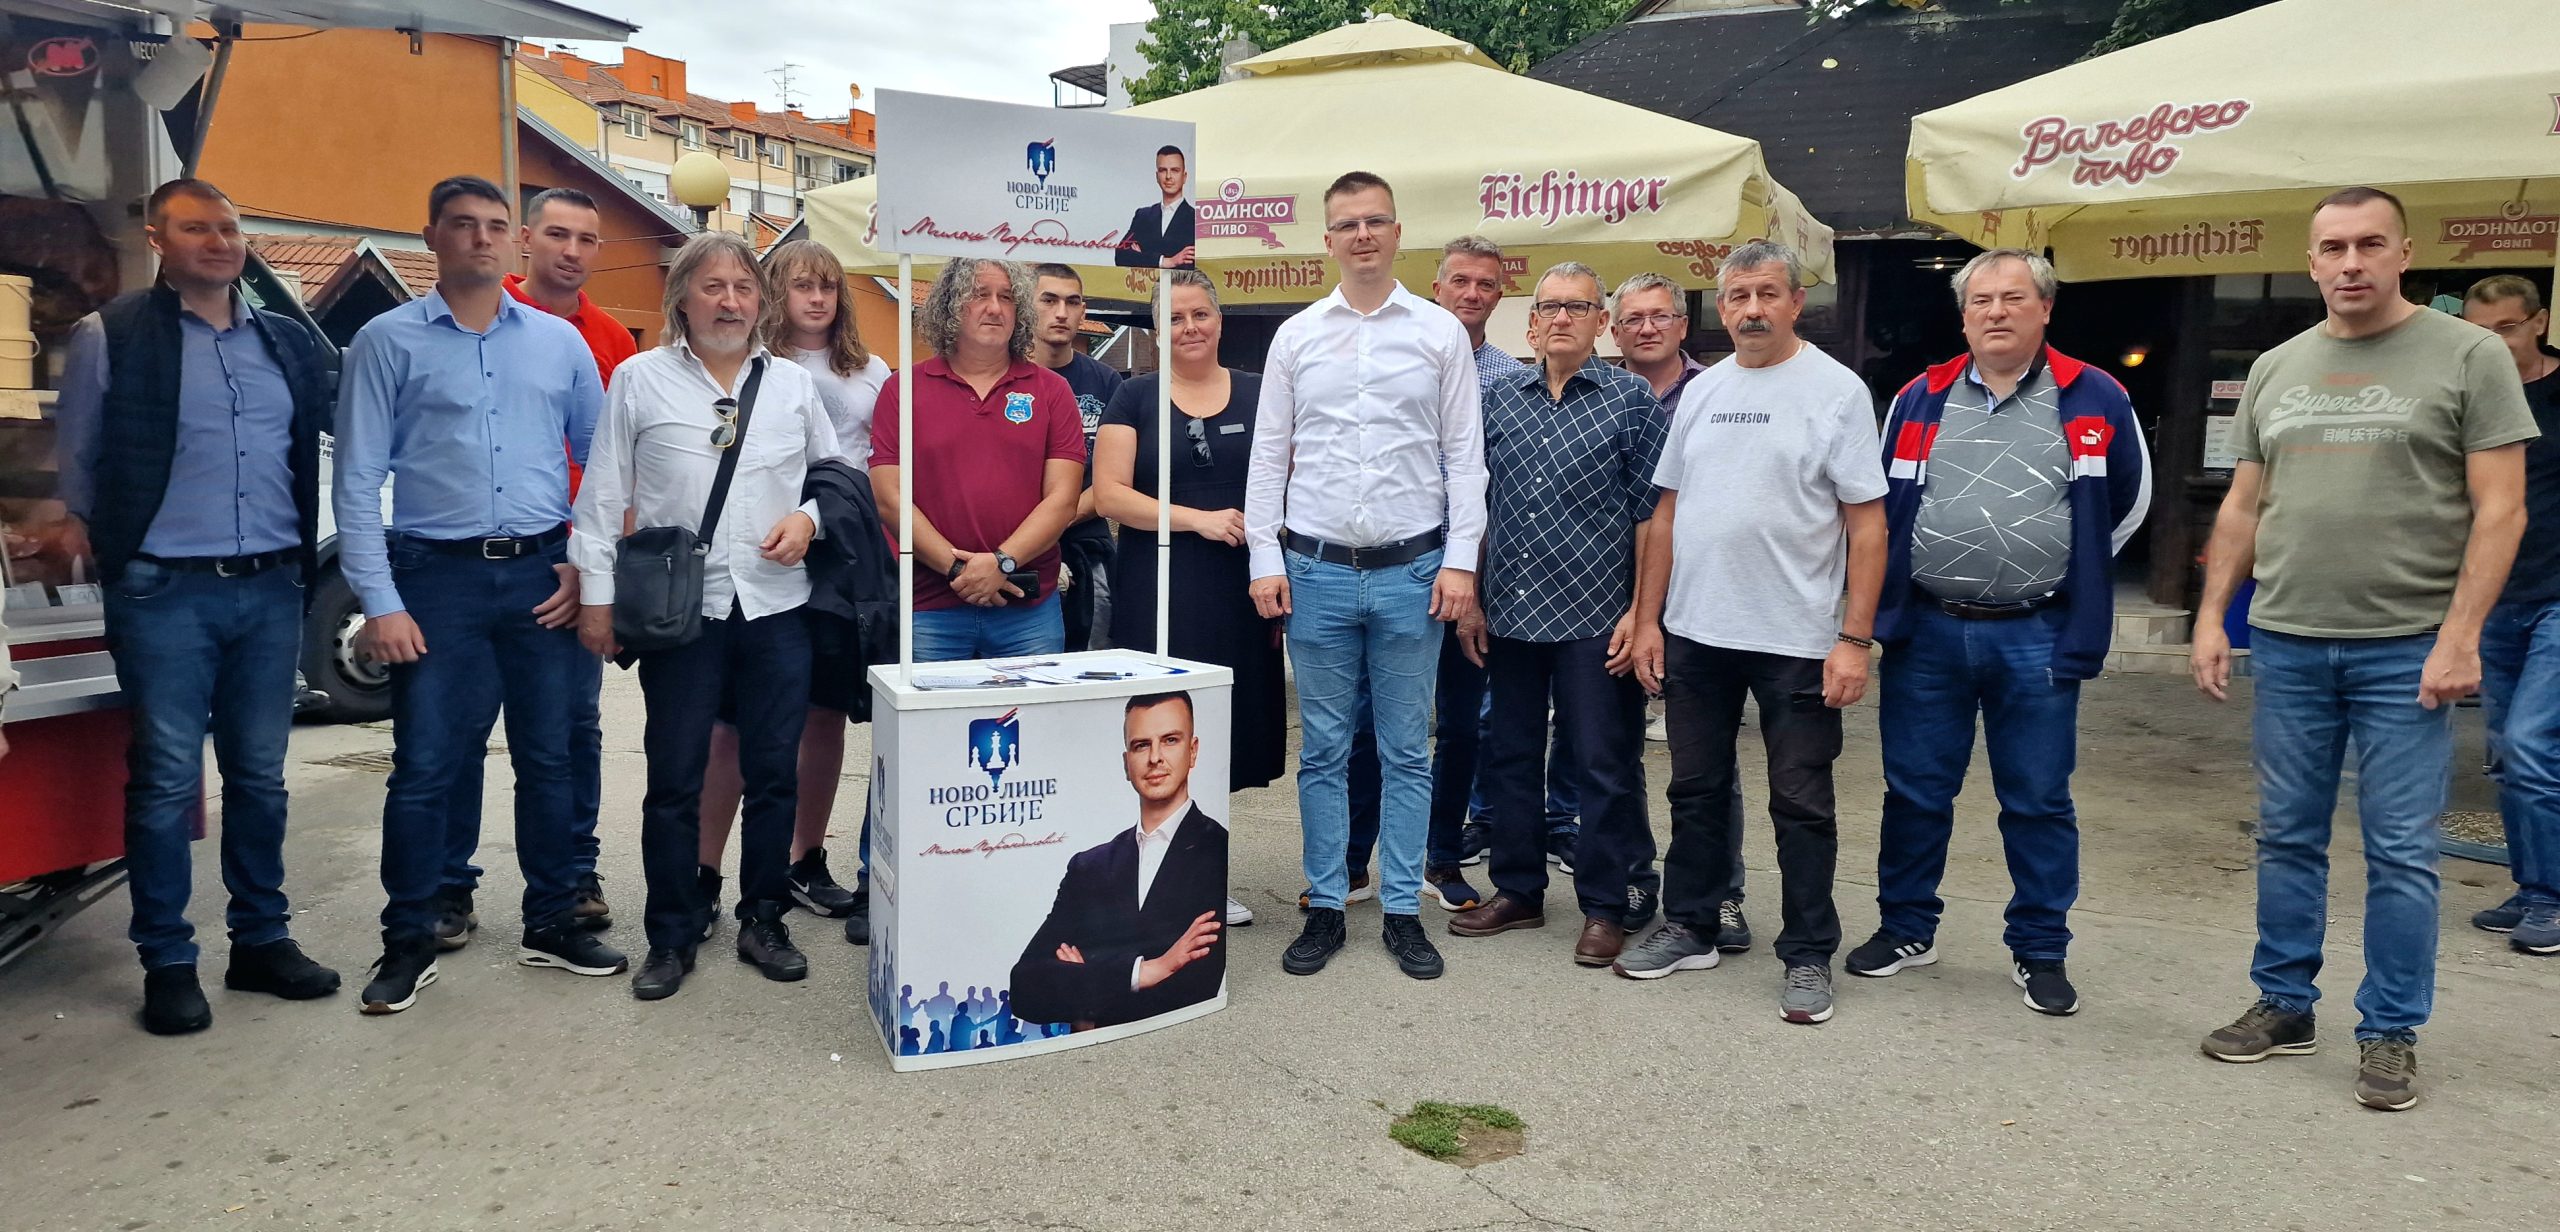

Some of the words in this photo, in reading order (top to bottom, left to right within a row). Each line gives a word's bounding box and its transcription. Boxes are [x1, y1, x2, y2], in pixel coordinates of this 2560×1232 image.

[1007, 181, 1040, 195] НОВО
[1044, 184, 1078, 199] ЛИЦЕ
[1479, 170, 1667, 227] Eichinger
[1015, 195, 1070, 214] СРБИЈЕ
[1211, 223, 1248, 236] ПИВО
[1710, 412, 1771, 424] CONVERSION
[929, 784, 989, 804] НОВО
[999, 778, 1057, 799] ЛИЦЕ
[945, 799, 1043, 828] СРБИЈЕ
